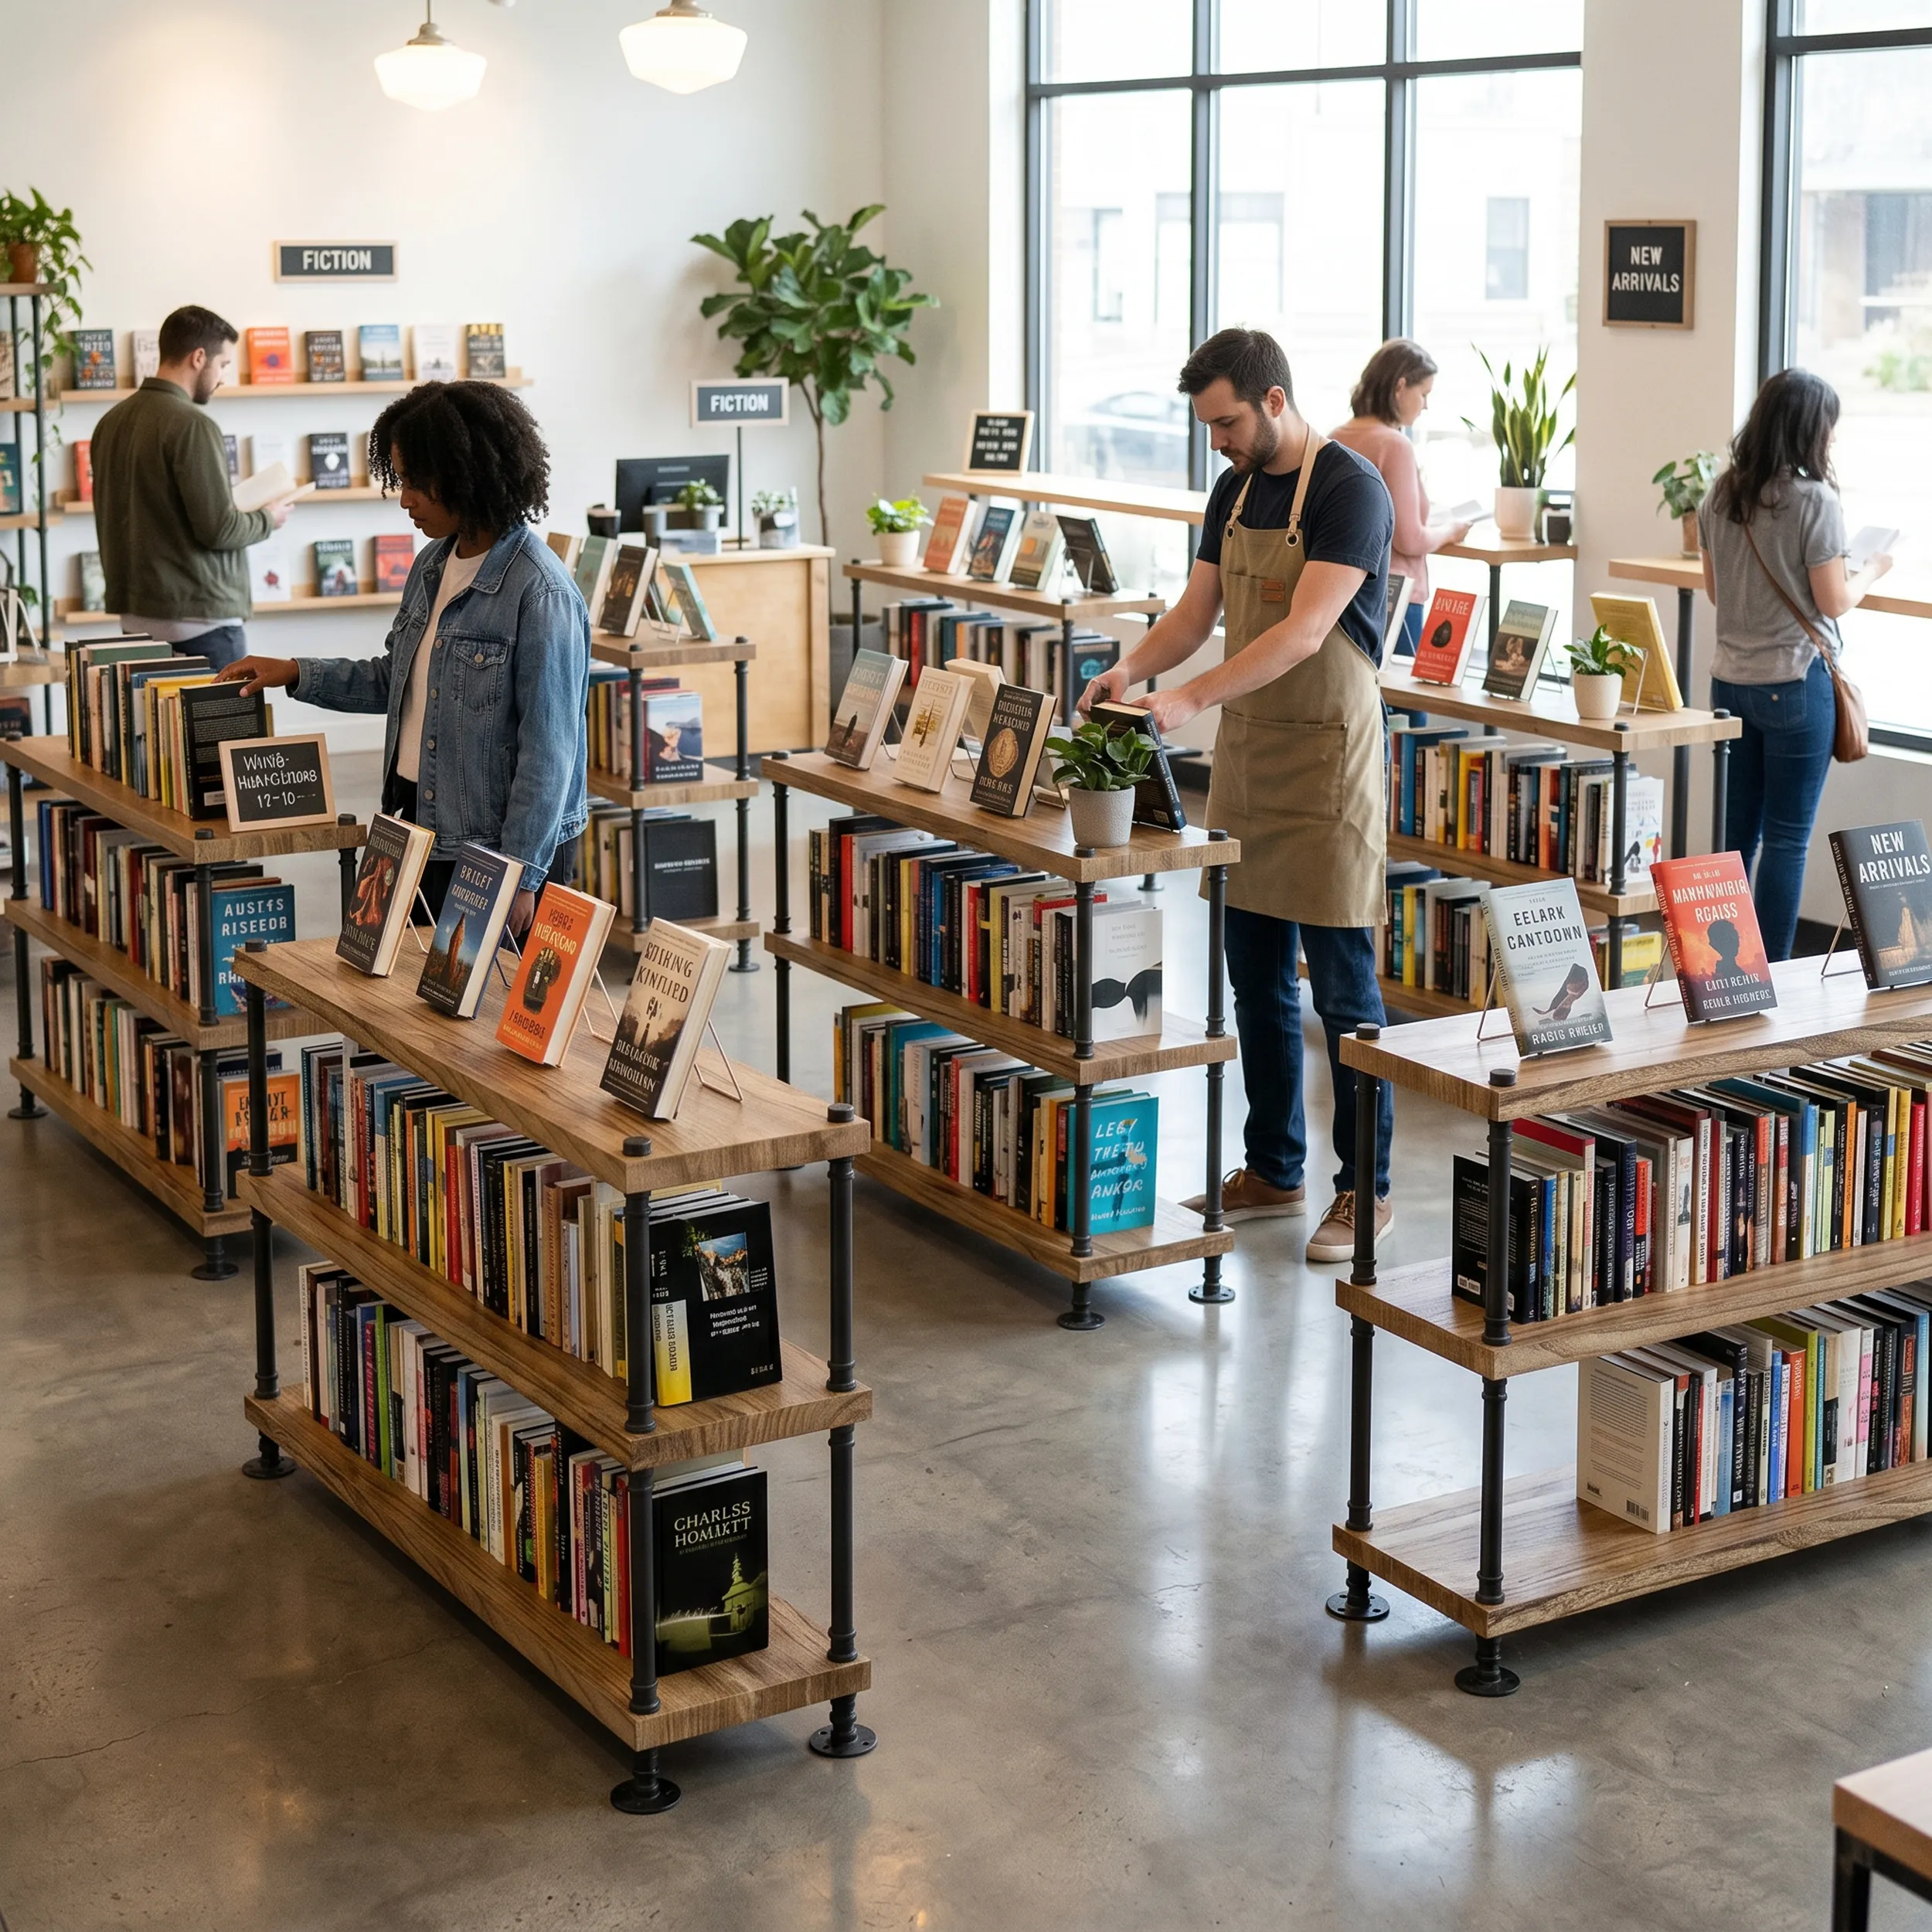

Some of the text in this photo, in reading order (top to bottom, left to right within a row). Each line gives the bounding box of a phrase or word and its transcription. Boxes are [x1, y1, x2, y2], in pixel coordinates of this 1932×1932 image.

[302, 250, 372, 271] FICTION
[1631, 246, 1663, 266] NEW
[1612, 272, 1680, 293] ARRIVALS
[709, 393, 770, 413] FICTION
[1869, 830, 1906, 855] NEW
[1858, 853, 1932, 884] ARRIVALS
[1512, 905, 1566, 927] EELARK
